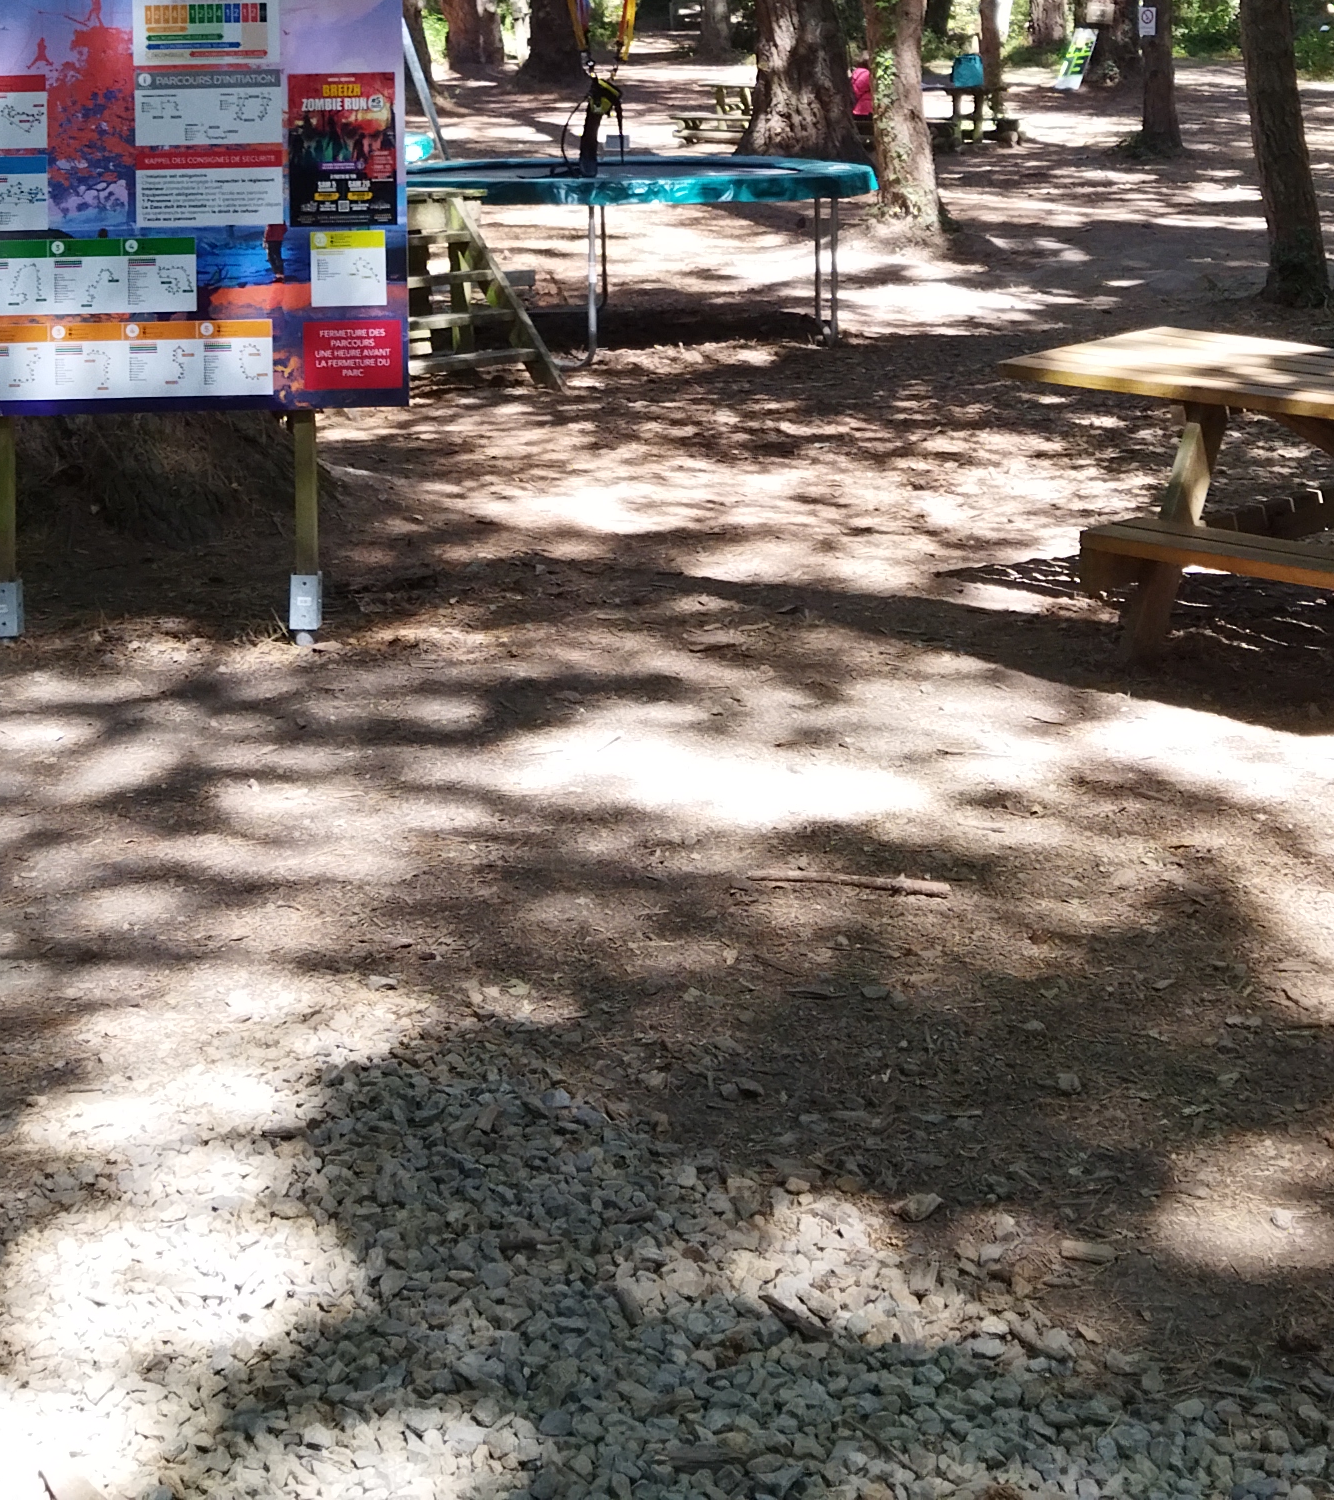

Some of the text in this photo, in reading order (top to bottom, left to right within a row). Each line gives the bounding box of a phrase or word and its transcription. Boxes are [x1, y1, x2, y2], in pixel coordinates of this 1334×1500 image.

[156, 74, 275, 86] PARCOURS D'INITIATION
[322, 84, 361, 97] BREIZH
[302, 97, 367, 111] ZOMBIE RUN
[187, 156, 229, 164] CONSIGNES
[319, 328, 386, 338] FERMETURE DES
[330, 338, 375, 348] PARCOURS
[315, 348, 391, 358] UNE HEURE AVANT
[315, 358, 391, 368] LA FERMETURE DU
[342, 369, 364, 377] PARC
